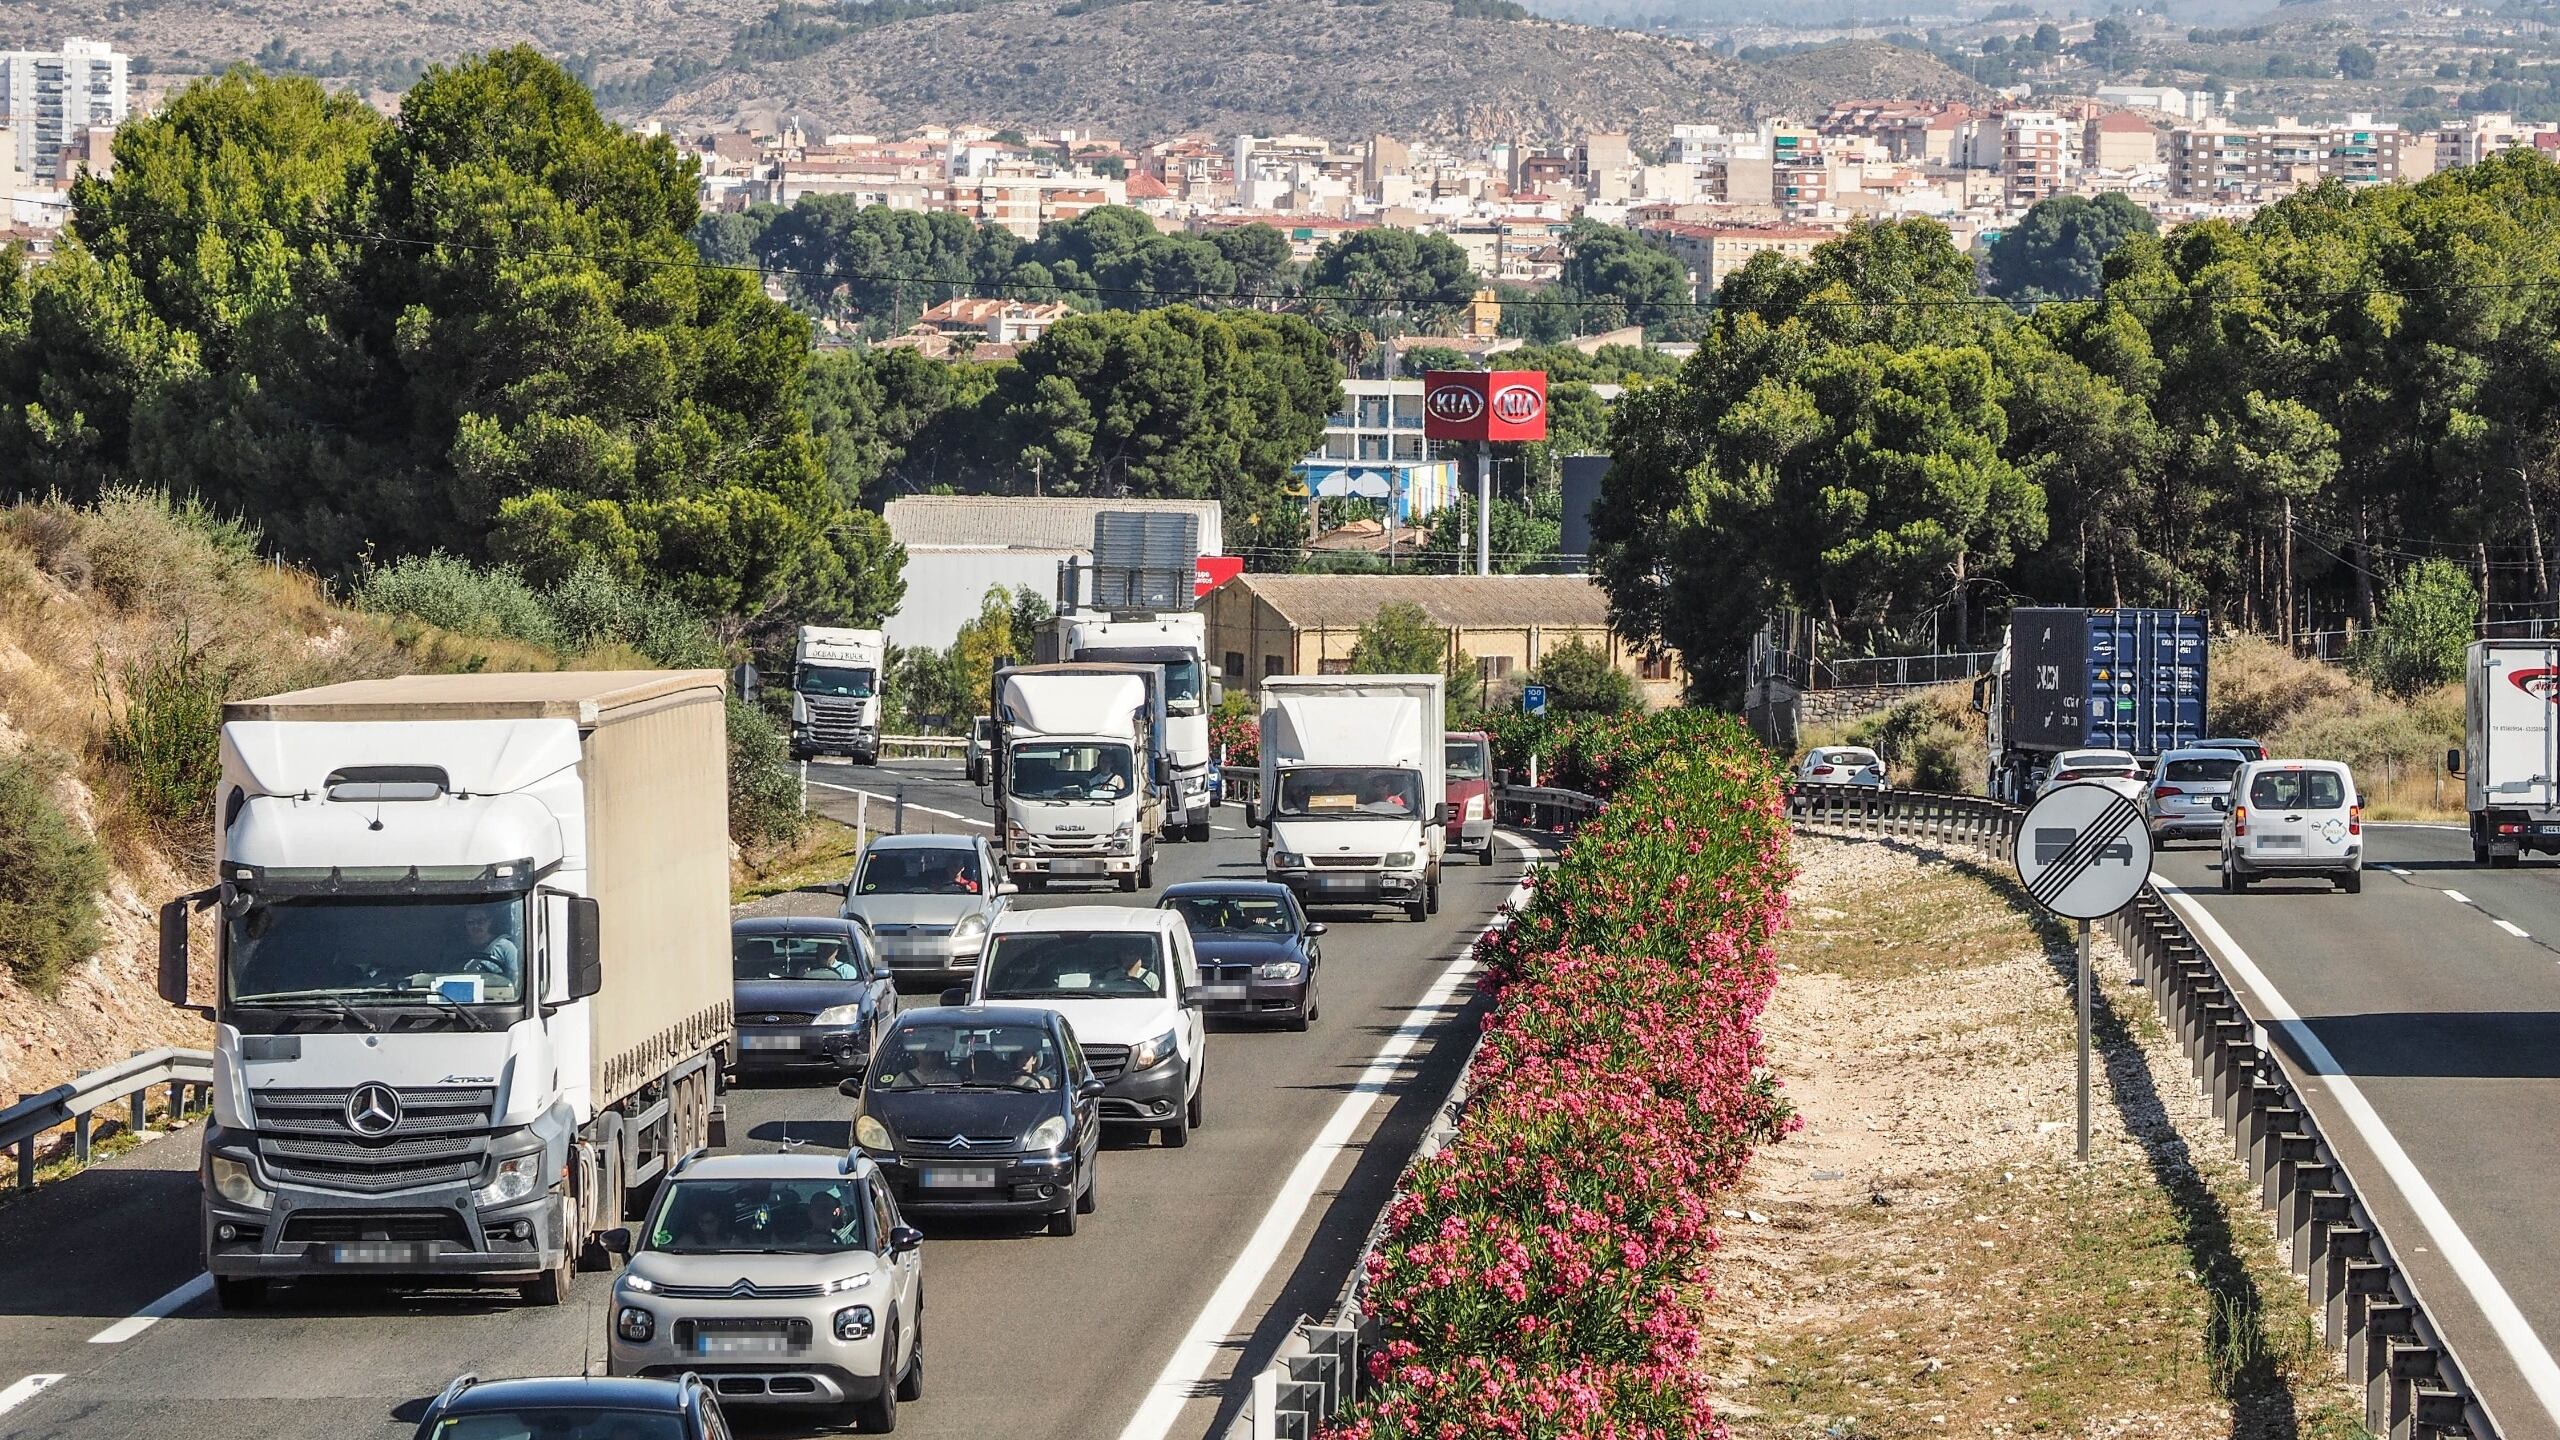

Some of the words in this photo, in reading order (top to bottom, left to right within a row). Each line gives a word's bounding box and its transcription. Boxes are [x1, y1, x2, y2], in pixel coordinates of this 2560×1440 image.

[1436, 393, 1474, 413] KIA
[1501, 393, 1534, 416] KIA
[812, 650, 837, 658] OCEAN
[840, 652, 864, 660] TRUCK
[437, 1074, 495, 1083] ACTROS
